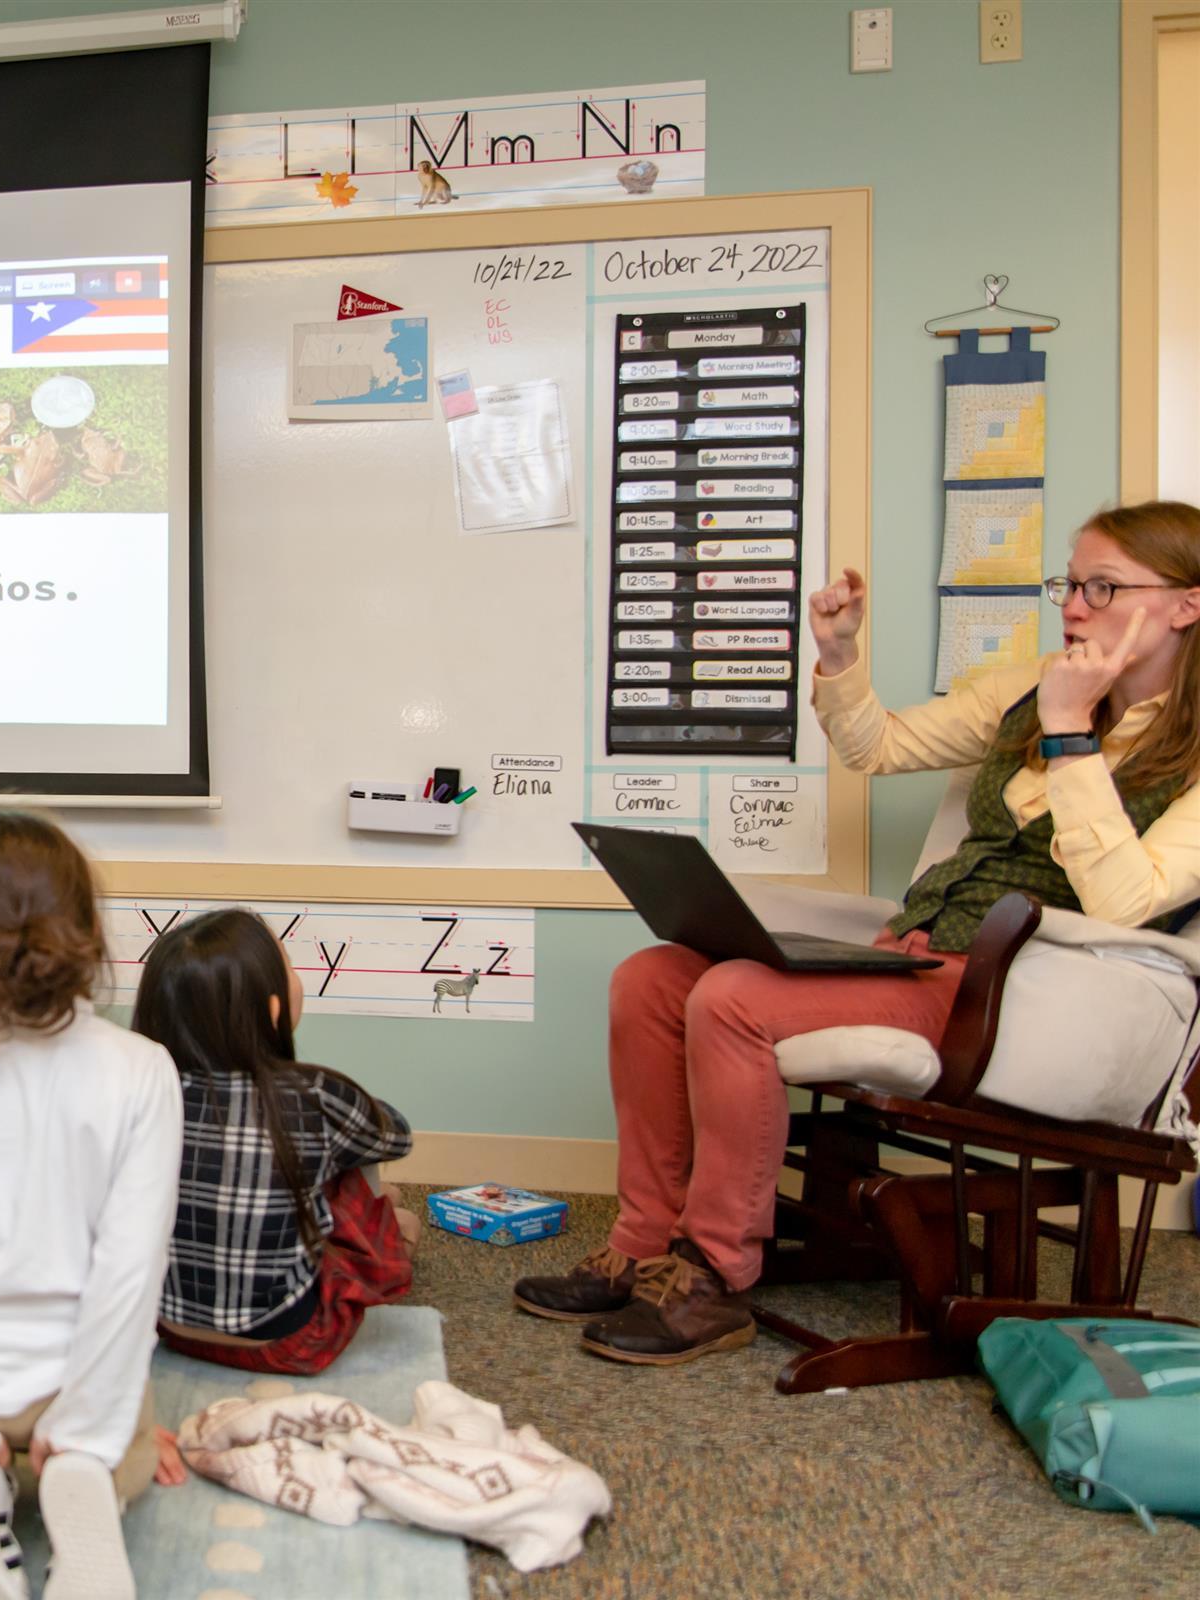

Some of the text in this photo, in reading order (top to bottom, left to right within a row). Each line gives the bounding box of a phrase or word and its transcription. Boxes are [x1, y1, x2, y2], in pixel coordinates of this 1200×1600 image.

[473, 254, 572, 290] 10/24/22
[604, 248, 702, 283] October
[356, 300, 388, 311] Stanford
[485, 299, 511, 315] EC
[627, 332, 736, 346] C Monday
[717, 361, 754, 372] Morning
[756, 358, 793, 370] Meeting
[632, 391, 768, 407] 8:20am Math
[724, 421, 753, 431] Word
[754, 420, 784, 432] Study
[628, 450, 790, 467] 9:40am Morning Break
[626, 483, 775, 496] 0:05am Reading
[626, 513, 763, 527] 10:45am Art
[629, 544, 773, 557] 11:25am Lunch
[626, 575, 777, 587] 12:05pm Wellness
[624, 604, 787, 616] 12:50pm World Language
[629, 634, 779, 645] 1:35pm PP Recess
[623, 664, 785, 676] 2:20pm Read Aloud
[621, 692, 772, 704] 3:00pm Dismissal
[498, 756, 556, 768] Attendance
[493, 773, 553, 797] Eliana
[626, 777, 664, 787] Leader
[749, 778, 780, 788] Share
[615, 791, 681, 812] Cormac
